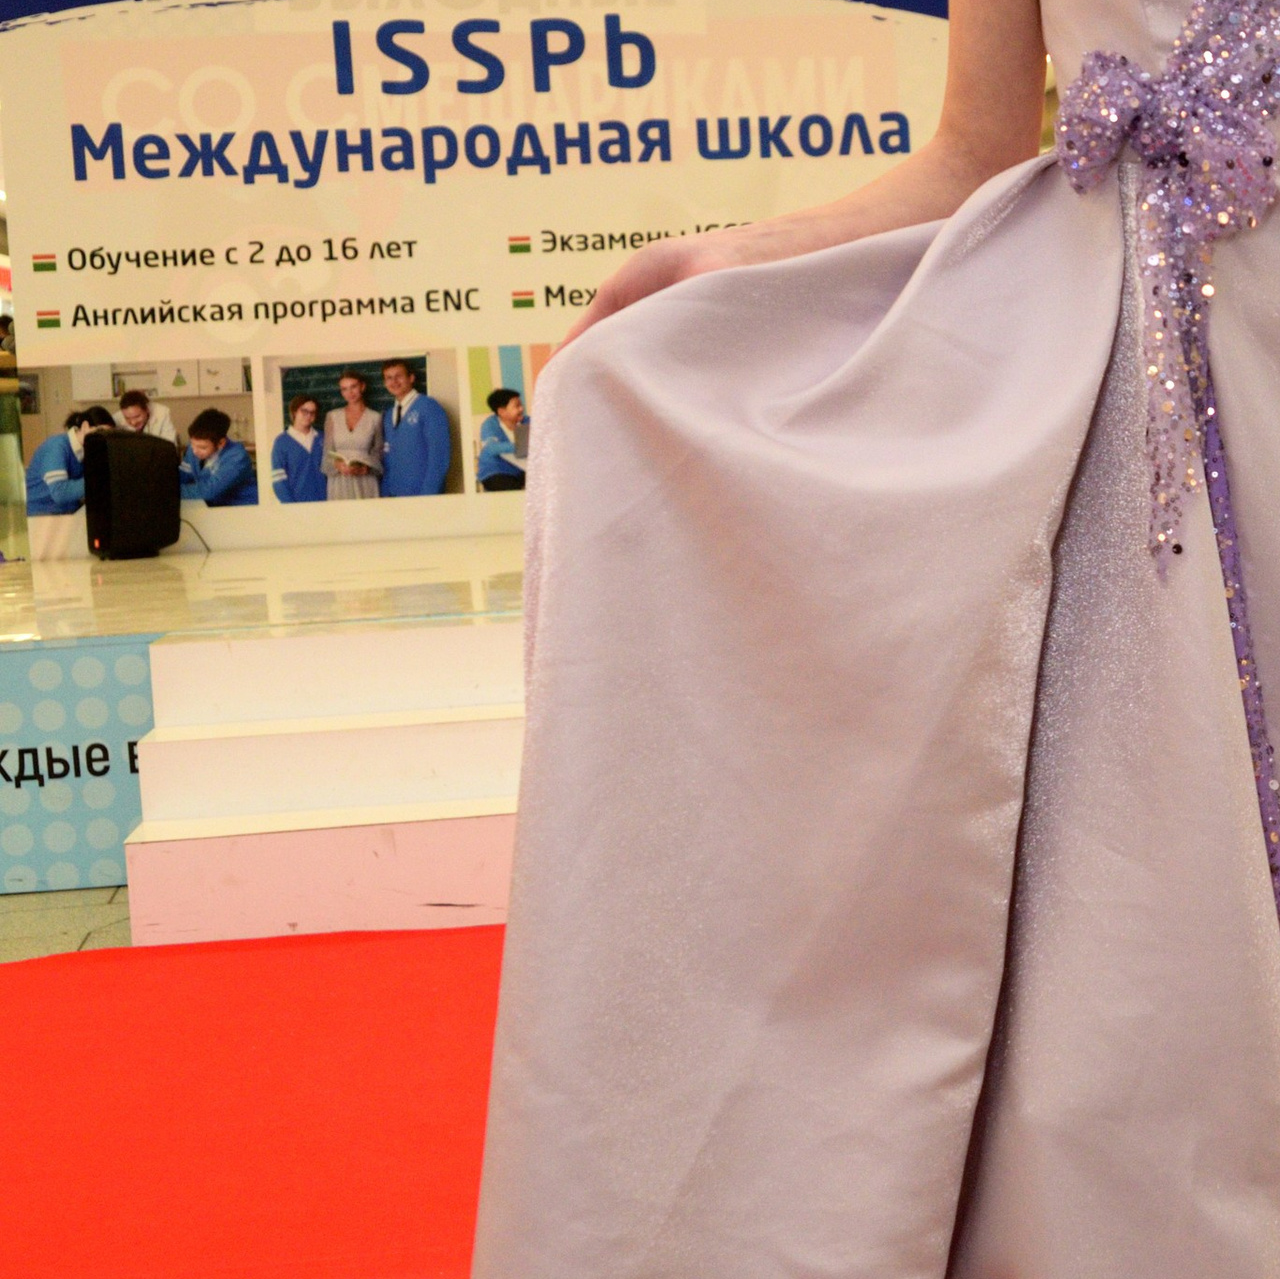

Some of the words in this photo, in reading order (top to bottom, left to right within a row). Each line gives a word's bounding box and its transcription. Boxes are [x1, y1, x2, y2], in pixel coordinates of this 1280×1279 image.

[332, 13, 656, 95] ISSPb
[71, 119, 671, 189] Международная
[697, 111, 911, 160] школа
[67, 245, 215, 275] Обучение
[225, 247, 239, 266] с
[248, 240, 266, 265] 2
[275, 244, 313, 267] до
[322, 237, 360, 262] 16
[368, 239, 418, 261] лет
[541, 229, 686, 253] Экзамен
[71, 299, 244, 328] Английская
[253, 295, 415, 324] программа
[426, 288, 481, 313] ENC
